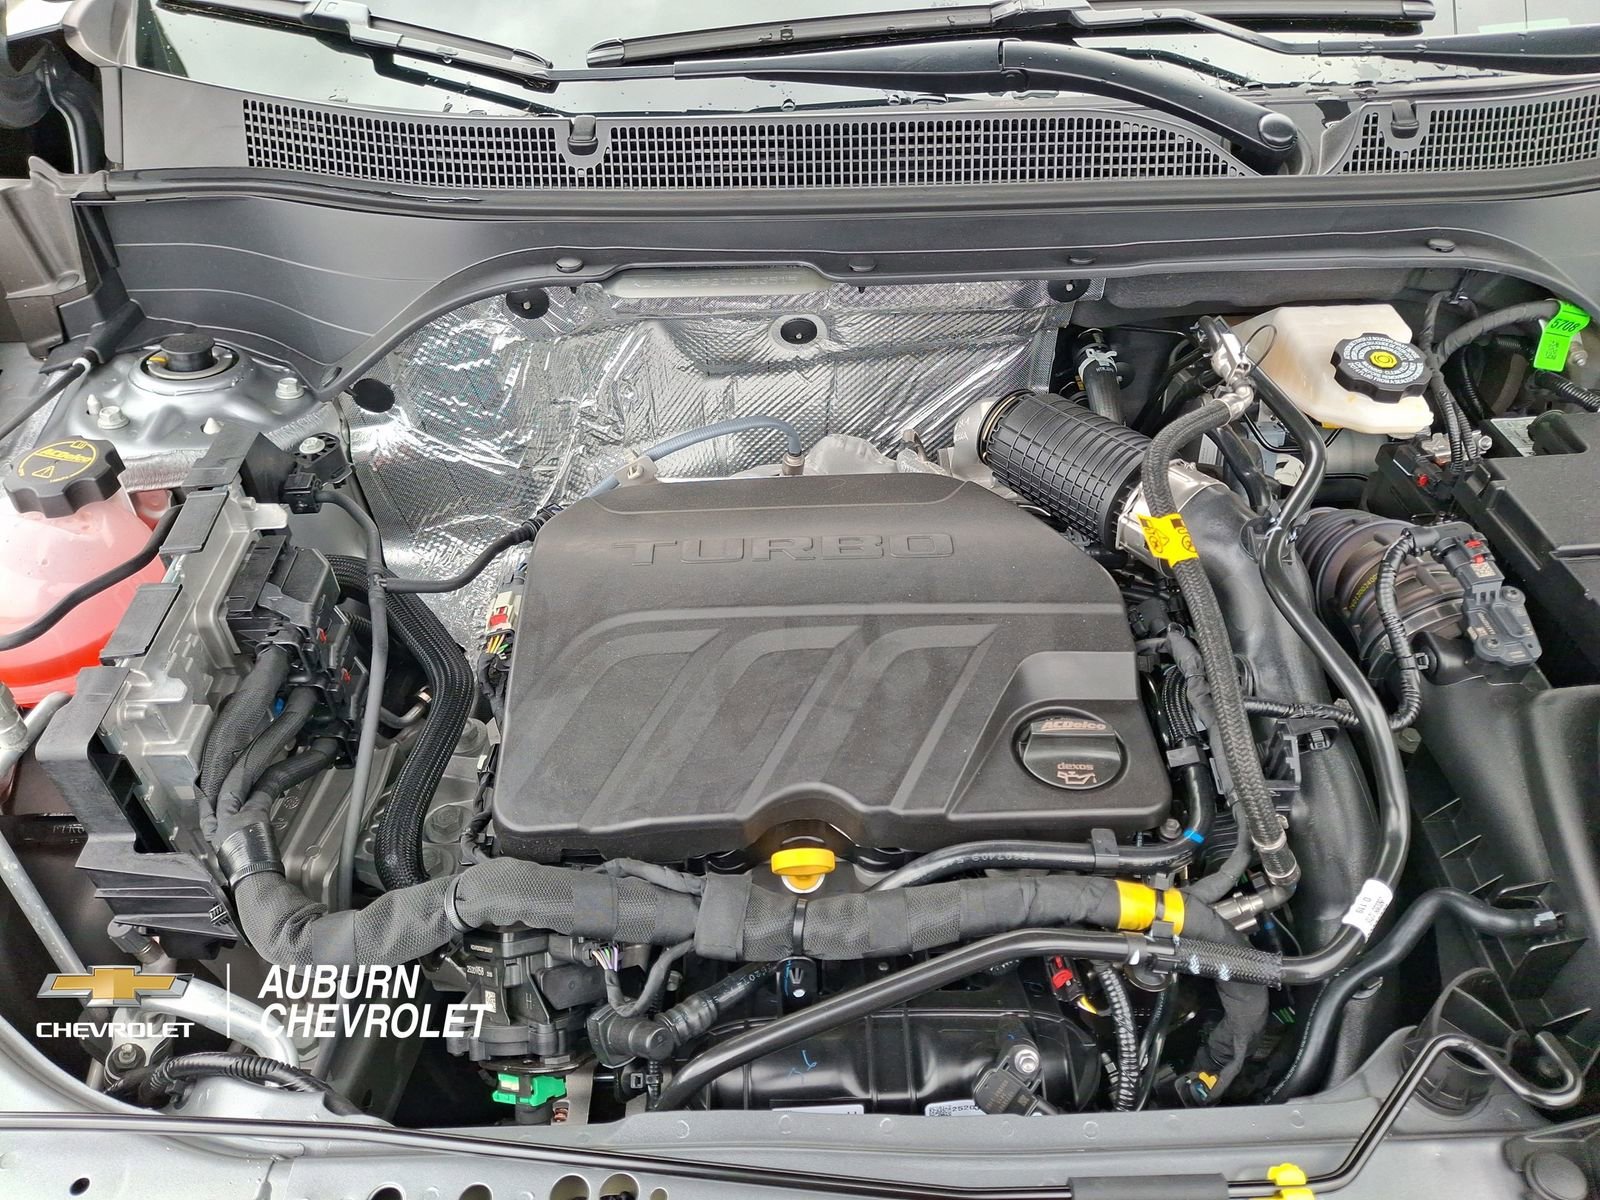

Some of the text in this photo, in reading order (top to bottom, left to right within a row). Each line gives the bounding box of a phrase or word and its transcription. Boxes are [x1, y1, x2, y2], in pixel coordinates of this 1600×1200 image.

[1550, 318, 1580, 332] 5708
[613, 532, 955, 566] TURBO
[1040, 721, 1107, 732] ACDelco
[1057, 762, 1095, 771] dexos
